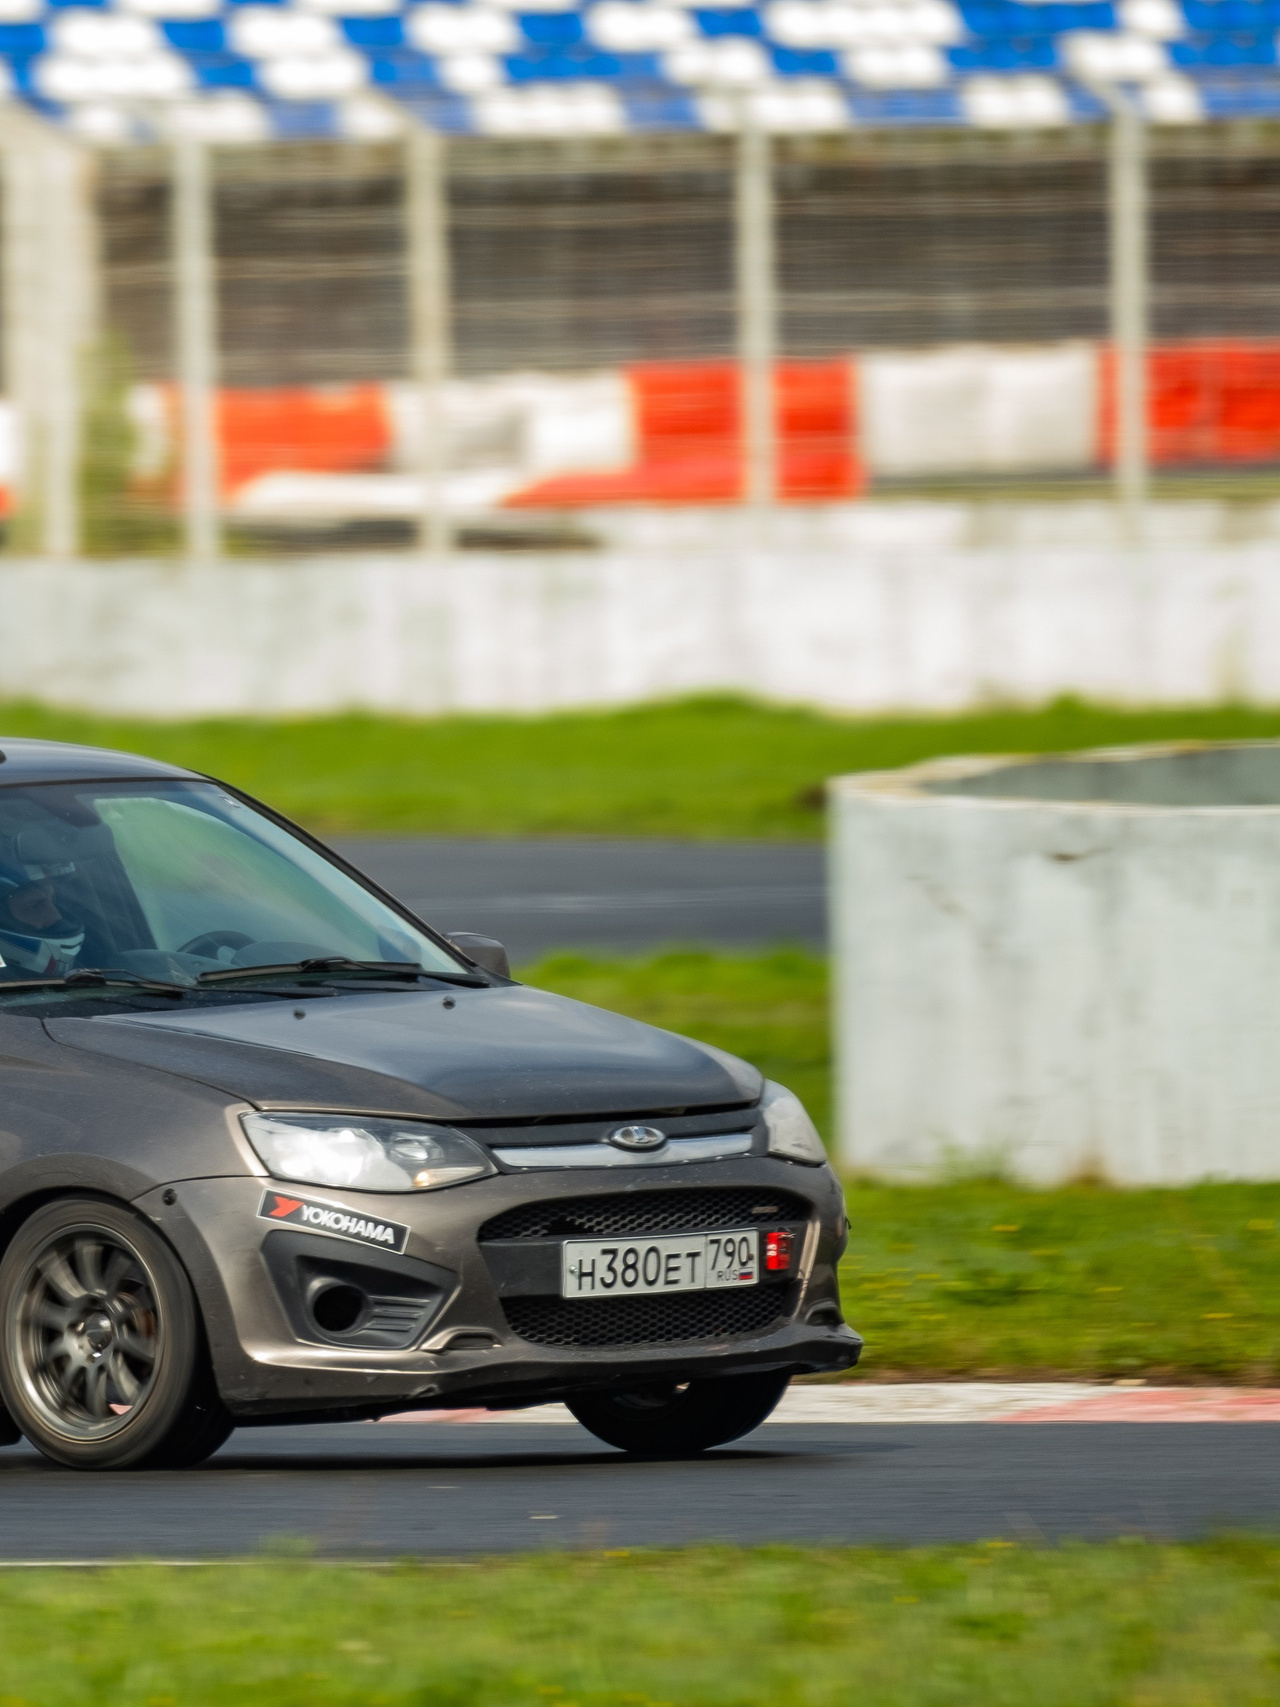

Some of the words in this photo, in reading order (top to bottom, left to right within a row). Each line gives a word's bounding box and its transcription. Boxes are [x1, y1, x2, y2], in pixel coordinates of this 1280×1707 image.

[301, 1204, 395, 1244] YOKOHAMA
[709, 1236, 750, 1271] 790
[716, 1269, 738, 1282] RUS
